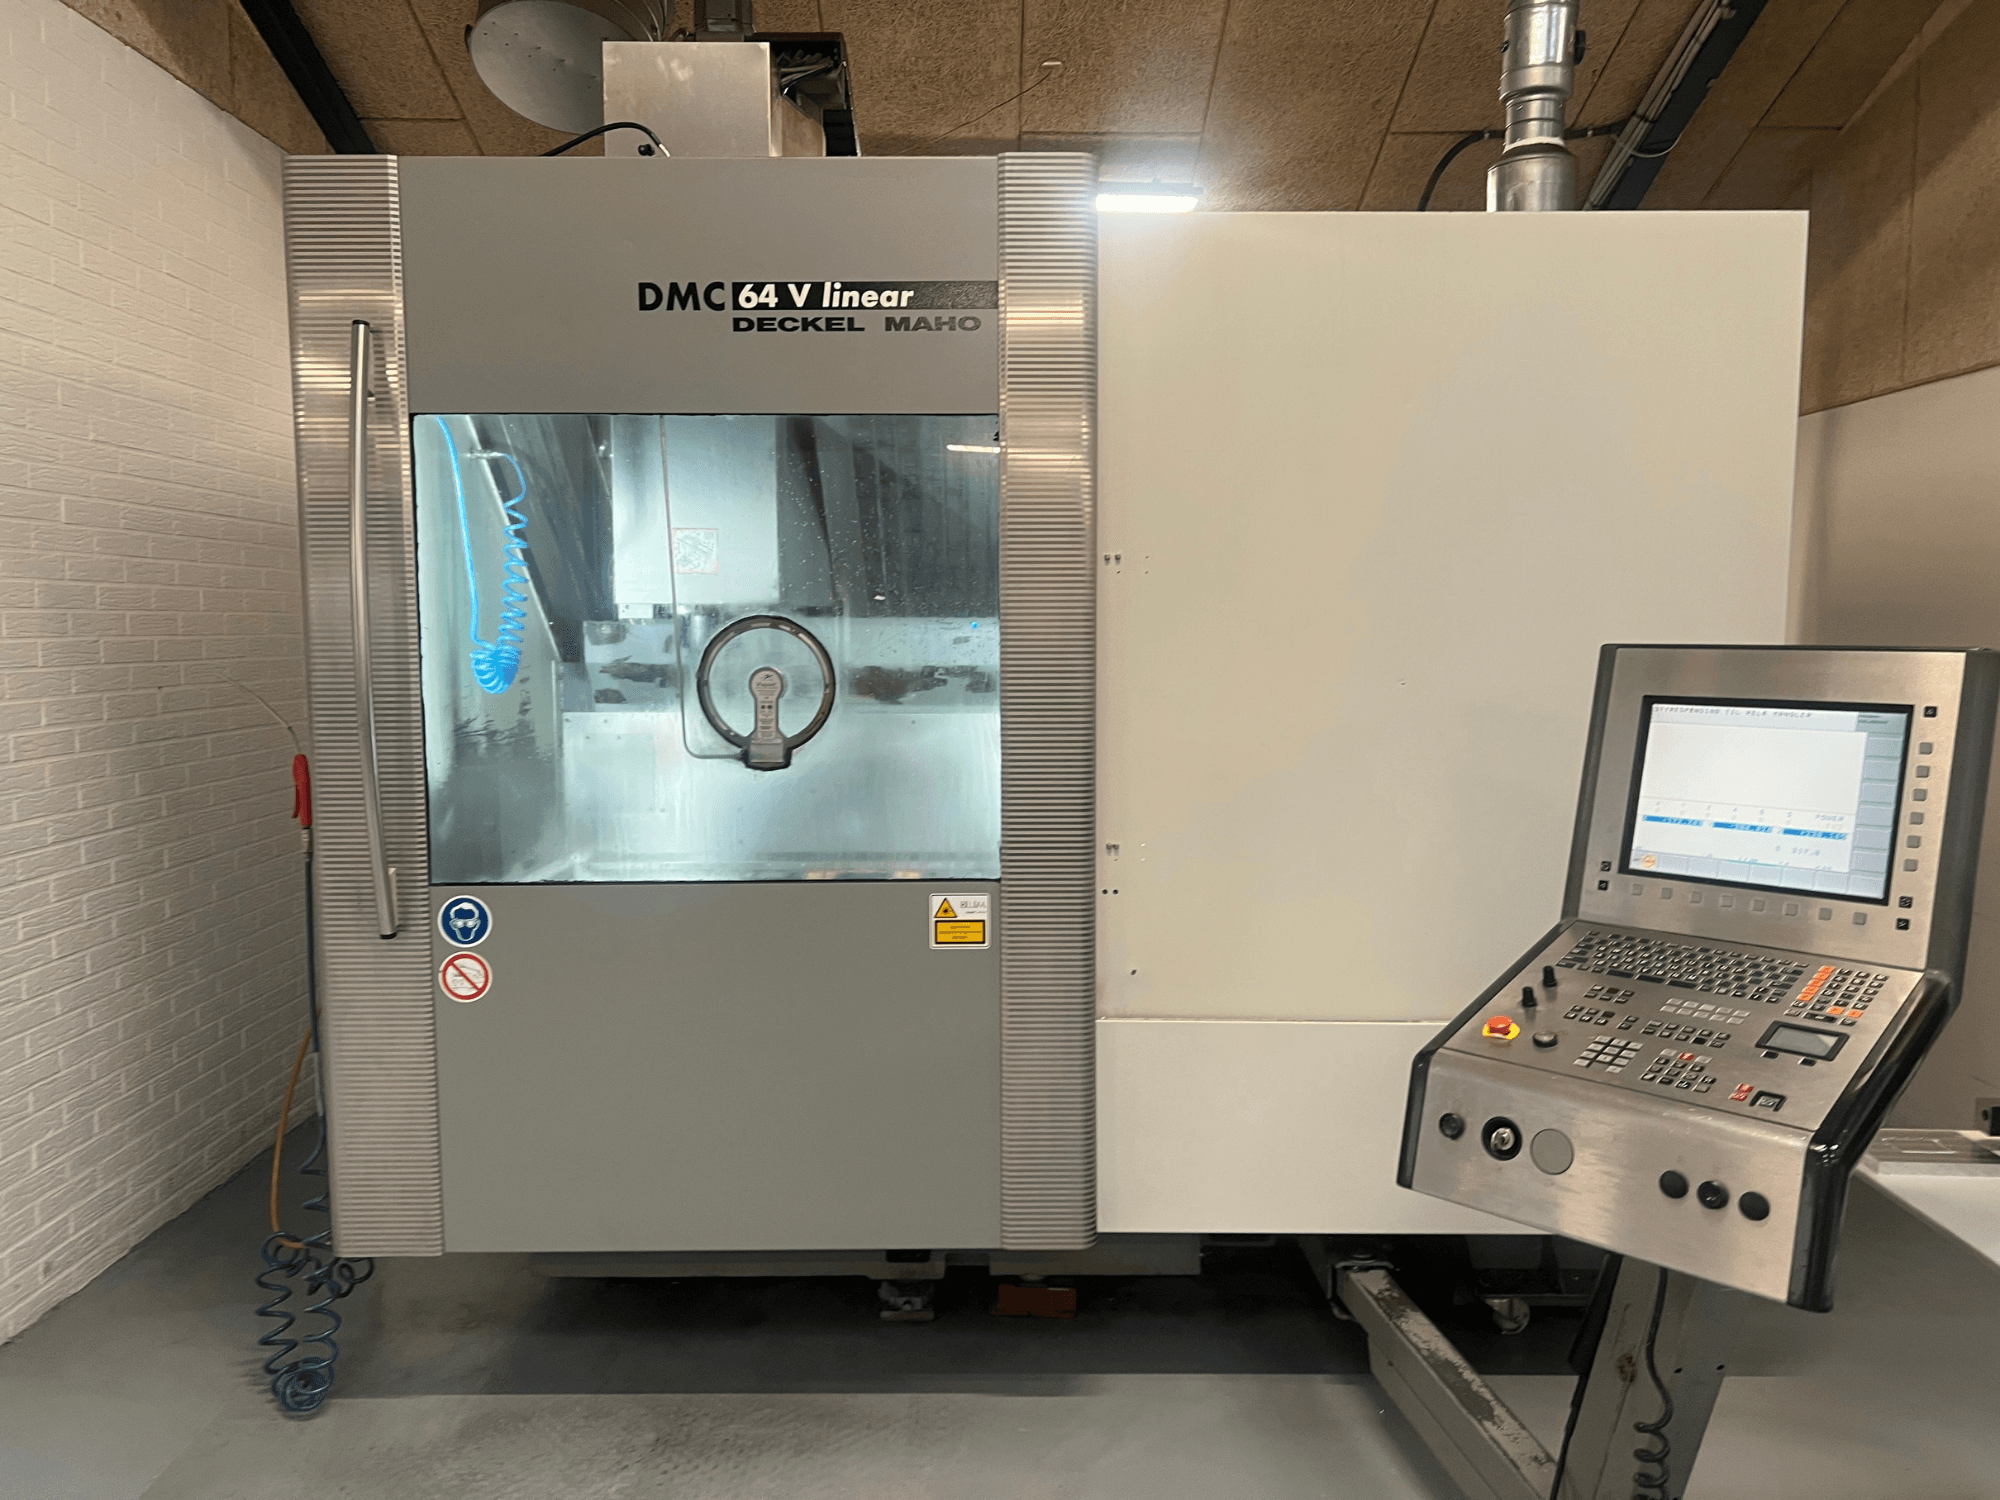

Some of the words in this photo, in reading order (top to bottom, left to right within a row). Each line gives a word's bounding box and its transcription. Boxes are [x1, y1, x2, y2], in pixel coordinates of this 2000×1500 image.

[638, 281, 725, 311] DMC
[738, 283, 778, 309] 64
[787, 283, 812, 308] V
[822, 281, 914, 308] linear
[732, 317, 865, 332] DECKEL
[884, 316, 982, 331] MAHO
